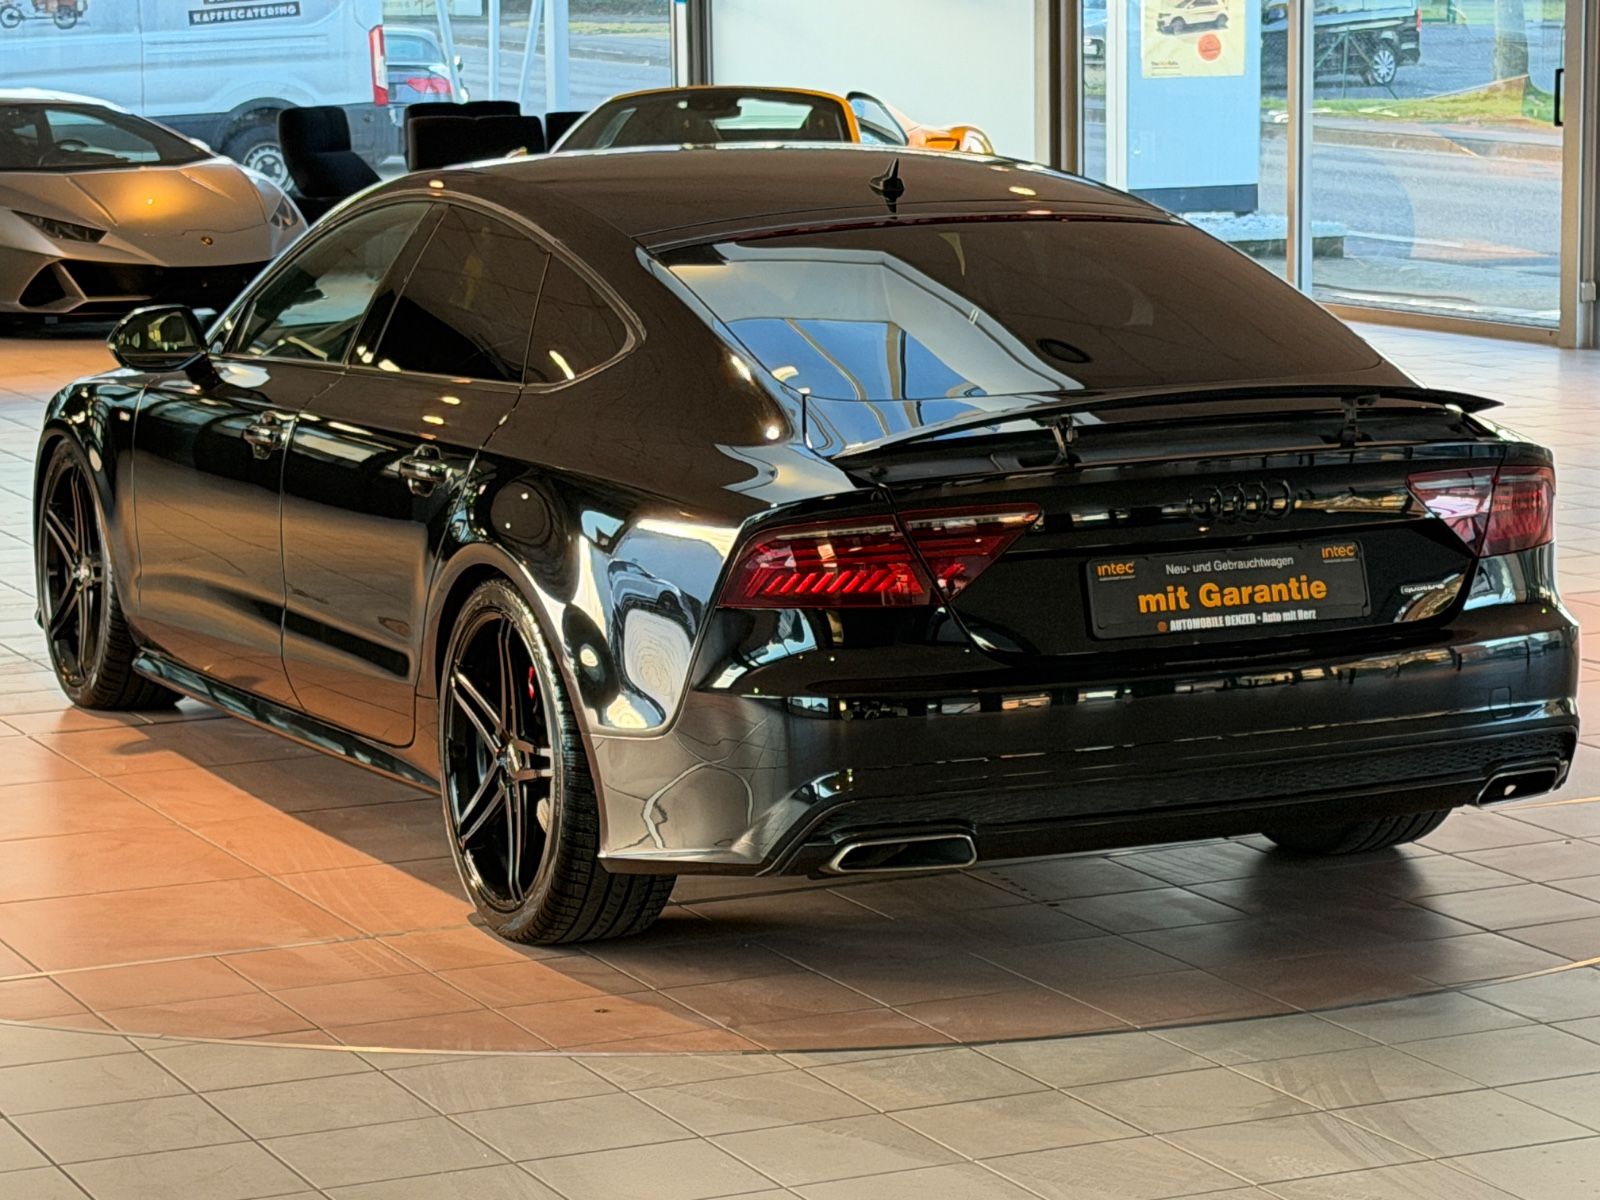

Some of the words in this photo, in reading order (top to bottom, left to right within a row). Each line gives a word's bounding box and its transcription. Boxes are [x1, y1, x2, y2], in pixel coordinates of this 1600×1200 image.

[193, 5, 297, 23] KAFFEECATERING
[1321, 544, 1356, 558] intec
[1097, 561, 1135, 576] intec
[1165, 564, 1190, 575] Neu-
[1192, 561, 1211, 572] und
[1213, 557, 1294, 571] Gebrauchtwagen
[1138, 585, 1190, 613] mit
[1199, 575, 1327, 607] Garantie
[1170, 615, 1224, 631] AUTOMOBILE
[1262, 611, 1281, 623] Auto
[1283, 610, 1296, 622] mit
[1297, 609, 1317, 620] Herz
